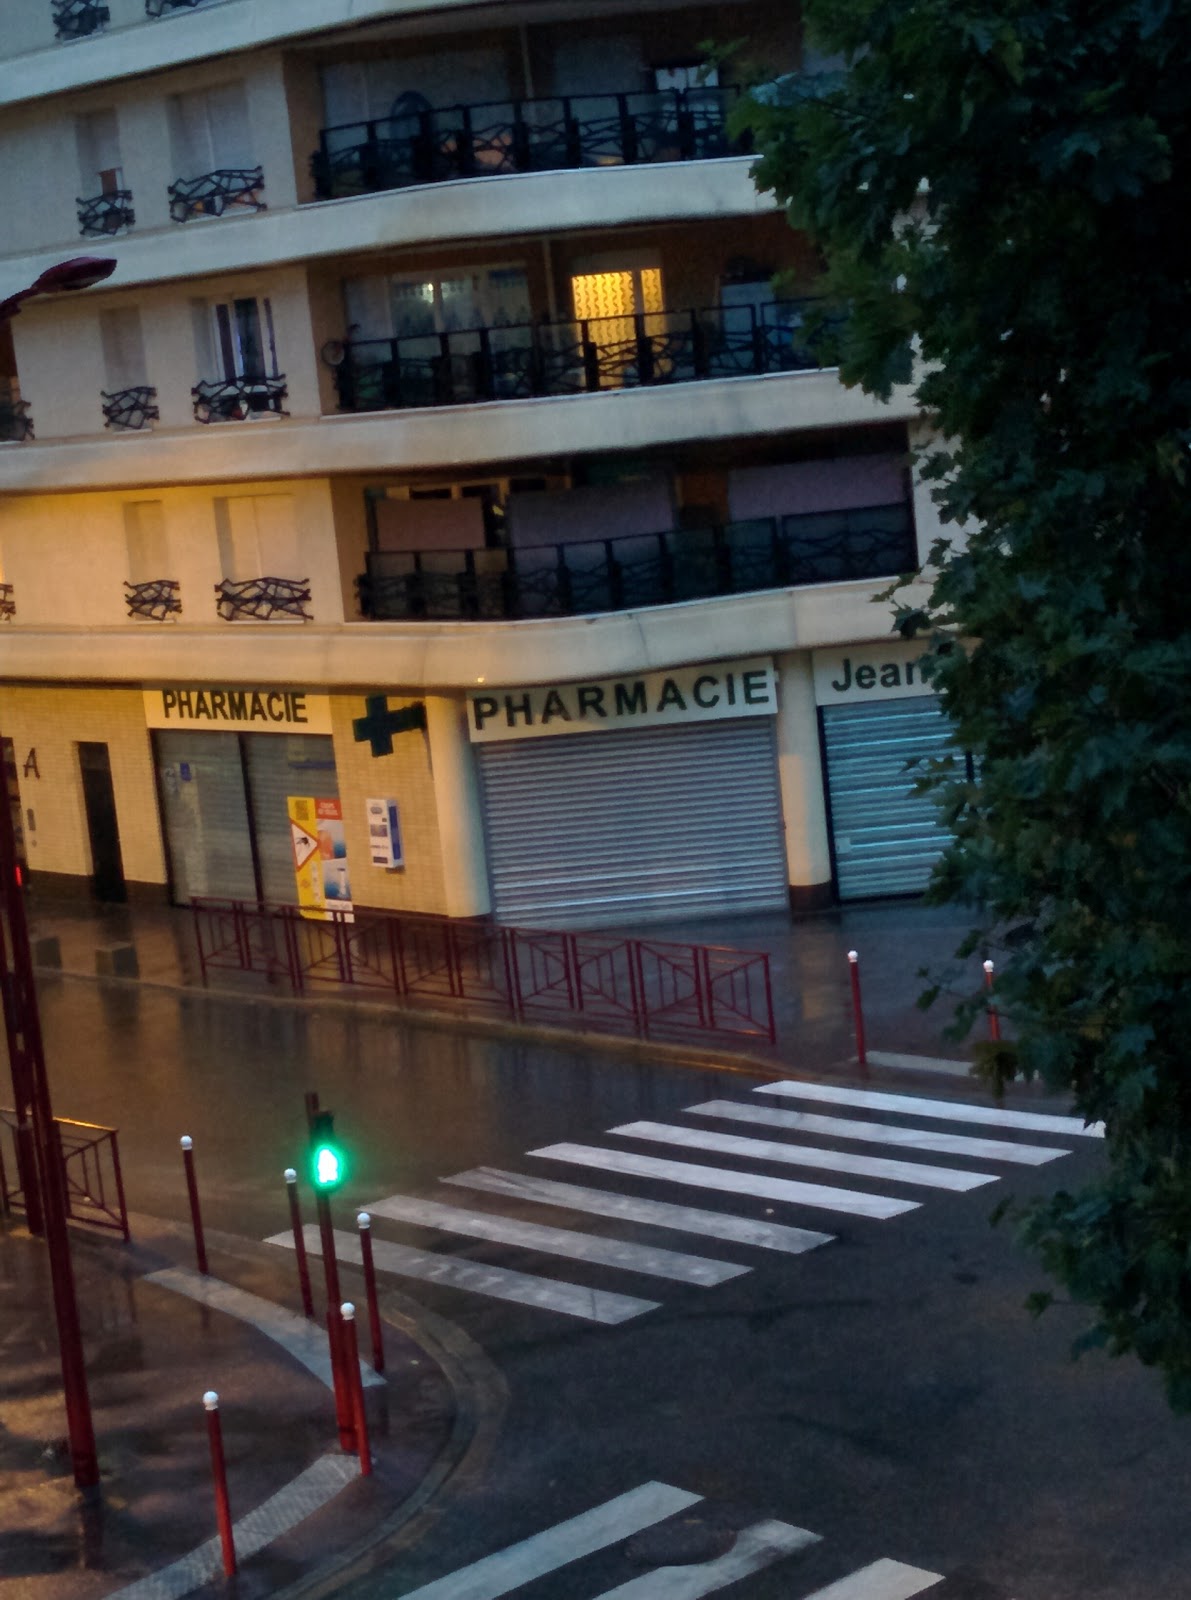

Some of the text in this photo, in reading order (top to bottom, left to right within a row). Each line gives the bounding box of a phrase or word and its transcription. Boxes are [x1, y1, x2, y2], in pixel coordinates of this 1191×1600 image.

[162, 689, 308, 723] PHARMACIE
[472, 670, 770, 730] PHARMACIE
[23, 747, 40, 779] A
